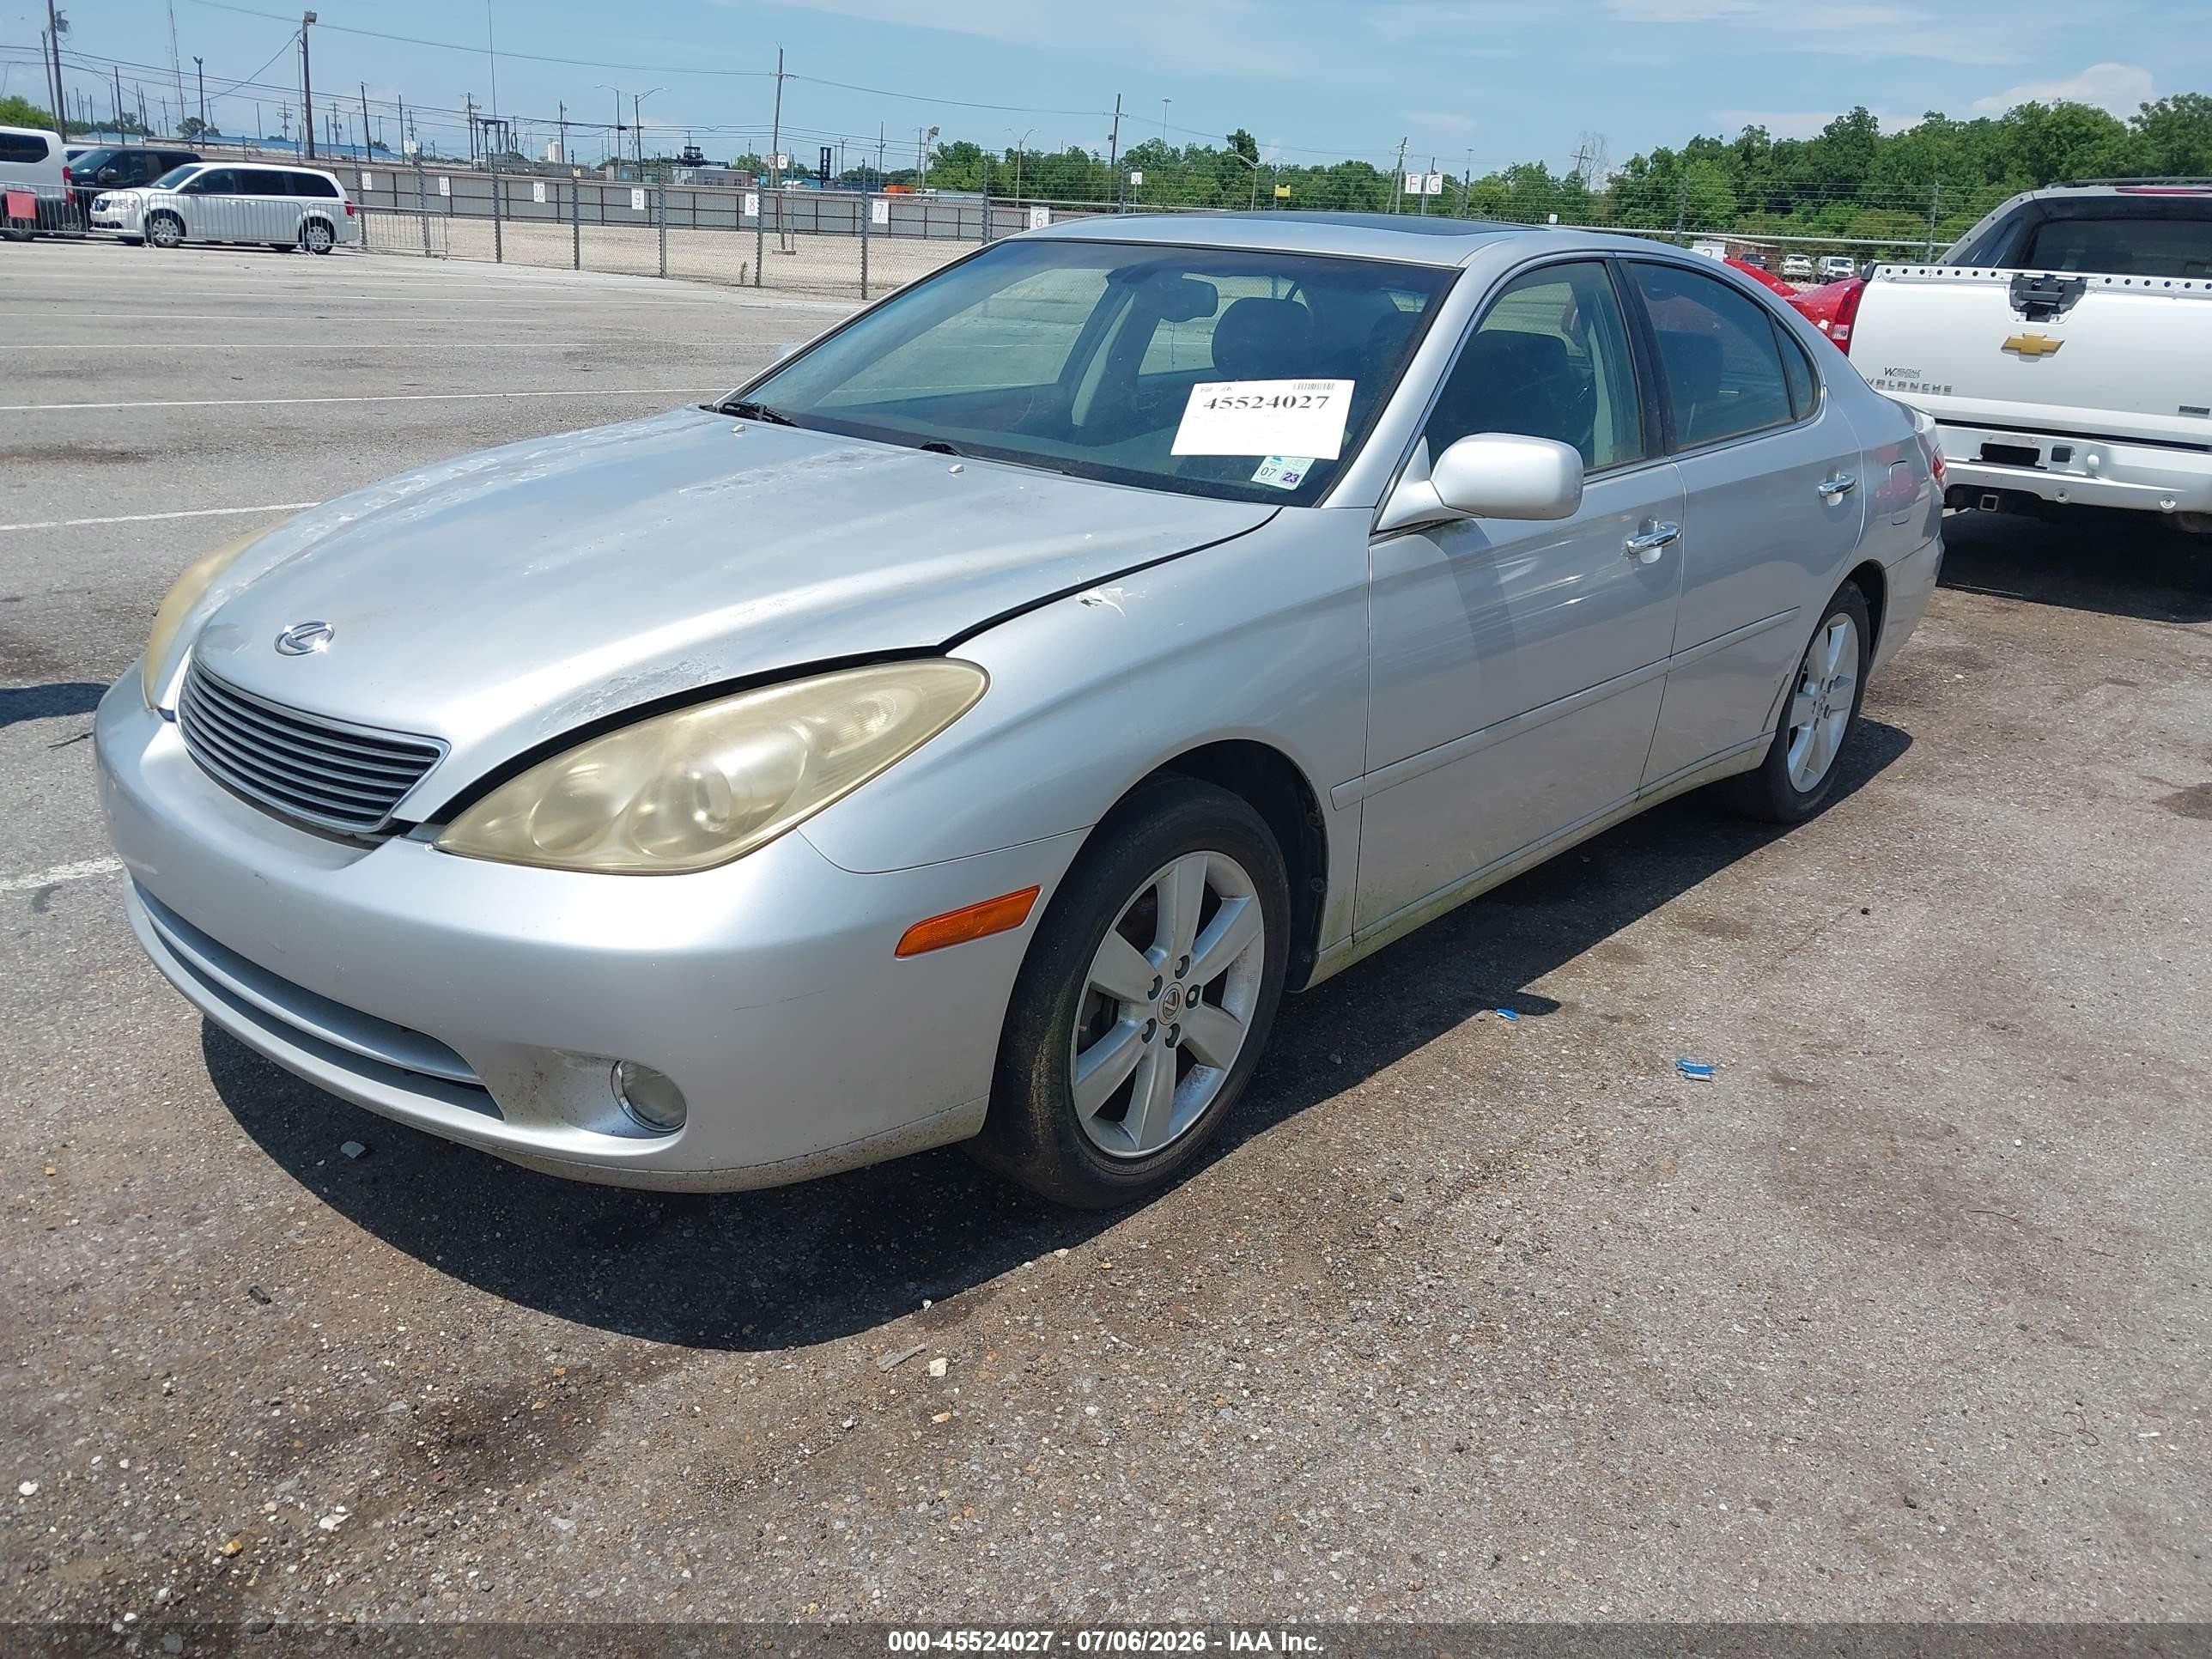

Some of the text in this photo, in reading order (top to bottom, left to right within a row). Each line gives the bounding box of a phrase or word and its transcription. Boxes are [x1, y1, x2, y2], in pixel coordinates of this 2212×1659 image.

[779, 156, 785, 166] C
[1408, 175, 1419, 192] F
[1428, 176, 1440, 193] G
[534, 185, 545, 198] 10
[635, 192, 641, 205] 9
[749, 198, 756, 212] 8
[877, 204, 884, 220] 7
[1036, 211, 1043, 228] 6
[1866, 379, 1952, 392] VALANCHE
[1203, 395, 1330, 410] 45524027
[1260, 466, 1278, 477] 07
[1282, 471, 1300, 483] 23
